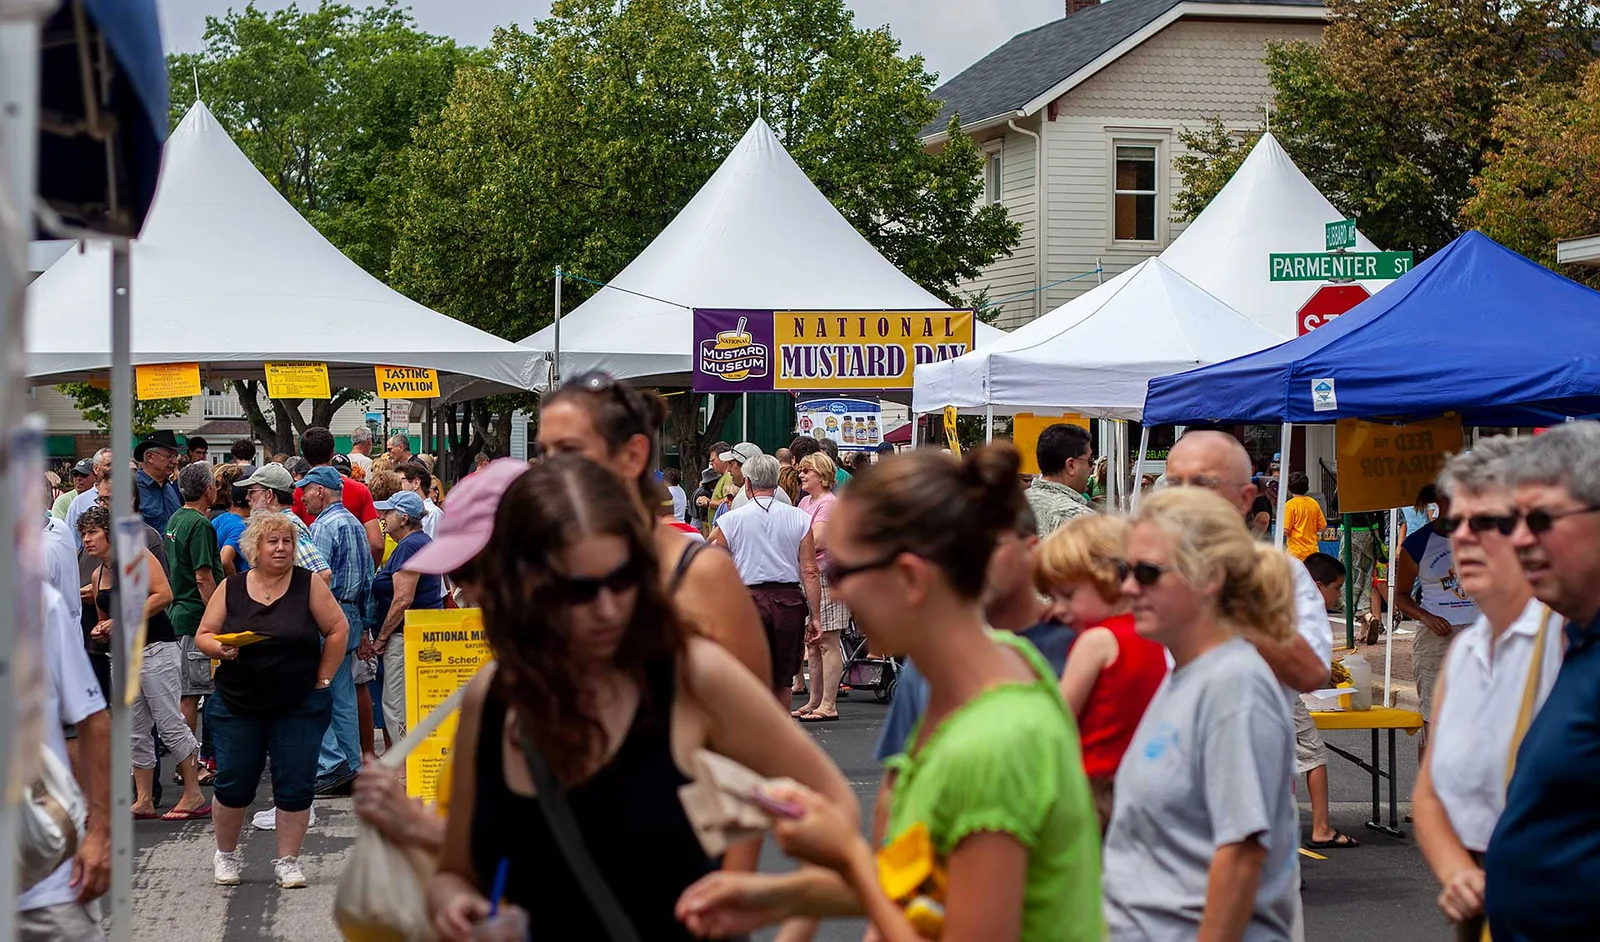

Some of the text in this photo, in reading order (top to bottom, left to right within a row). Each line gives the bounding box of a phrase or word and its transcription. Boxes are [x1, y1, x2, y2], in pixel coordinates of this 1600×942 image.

[1273, 256, 1410, 277] PARMENTER ST
[793, 316, 955, 338] NATIONAL
[703, 346, 765, 360] MUSTARD
[703, 358, 764, 373] MUSEUM
[782, 344, 907, 378] MUSTARD
[385, 368, 429, 379] TASTING
[383, 381, 433, 392] PAVILION
[422, 630, 468, 643] NATIONAL
